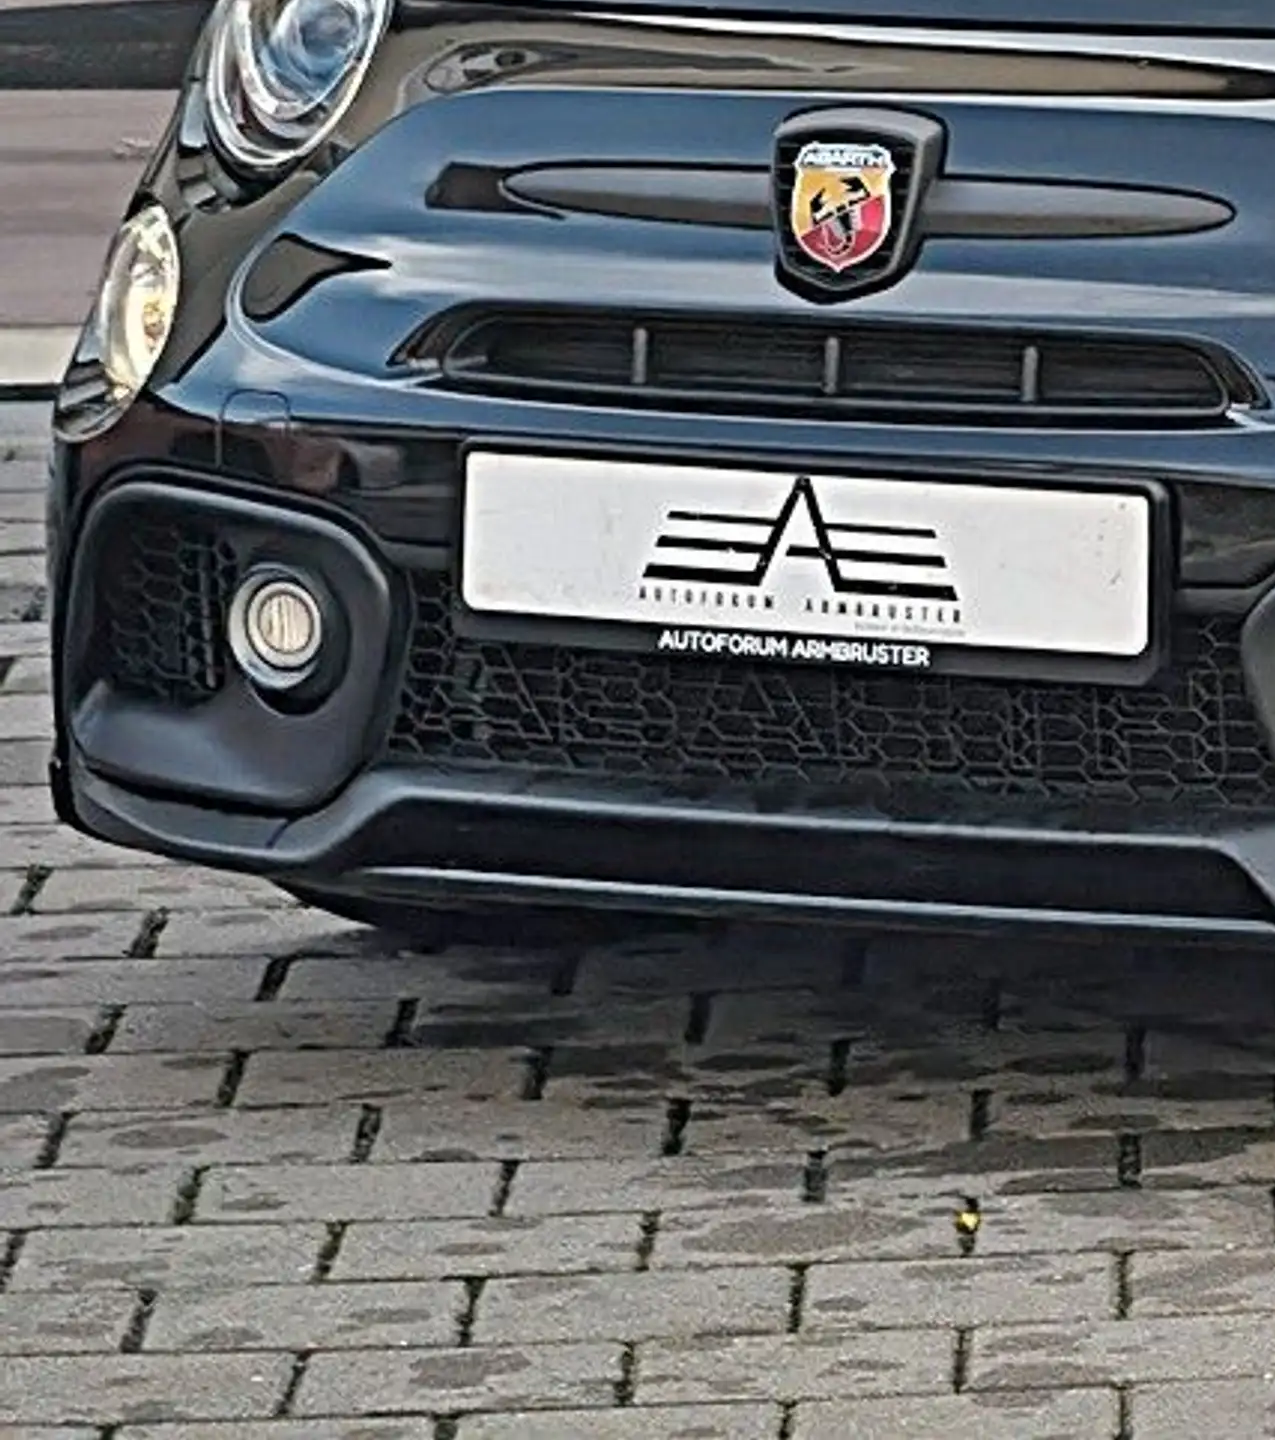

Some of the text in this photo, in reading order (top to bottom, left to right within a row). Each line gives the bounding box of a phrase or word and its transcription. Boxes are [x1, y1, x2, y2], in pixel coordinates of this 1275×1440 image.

[637, 584, 963, 625] AUTOFORUM ARMBRUSTER
[657, 629, 932, 668] AUTOFORUM ARMBRUSTER
